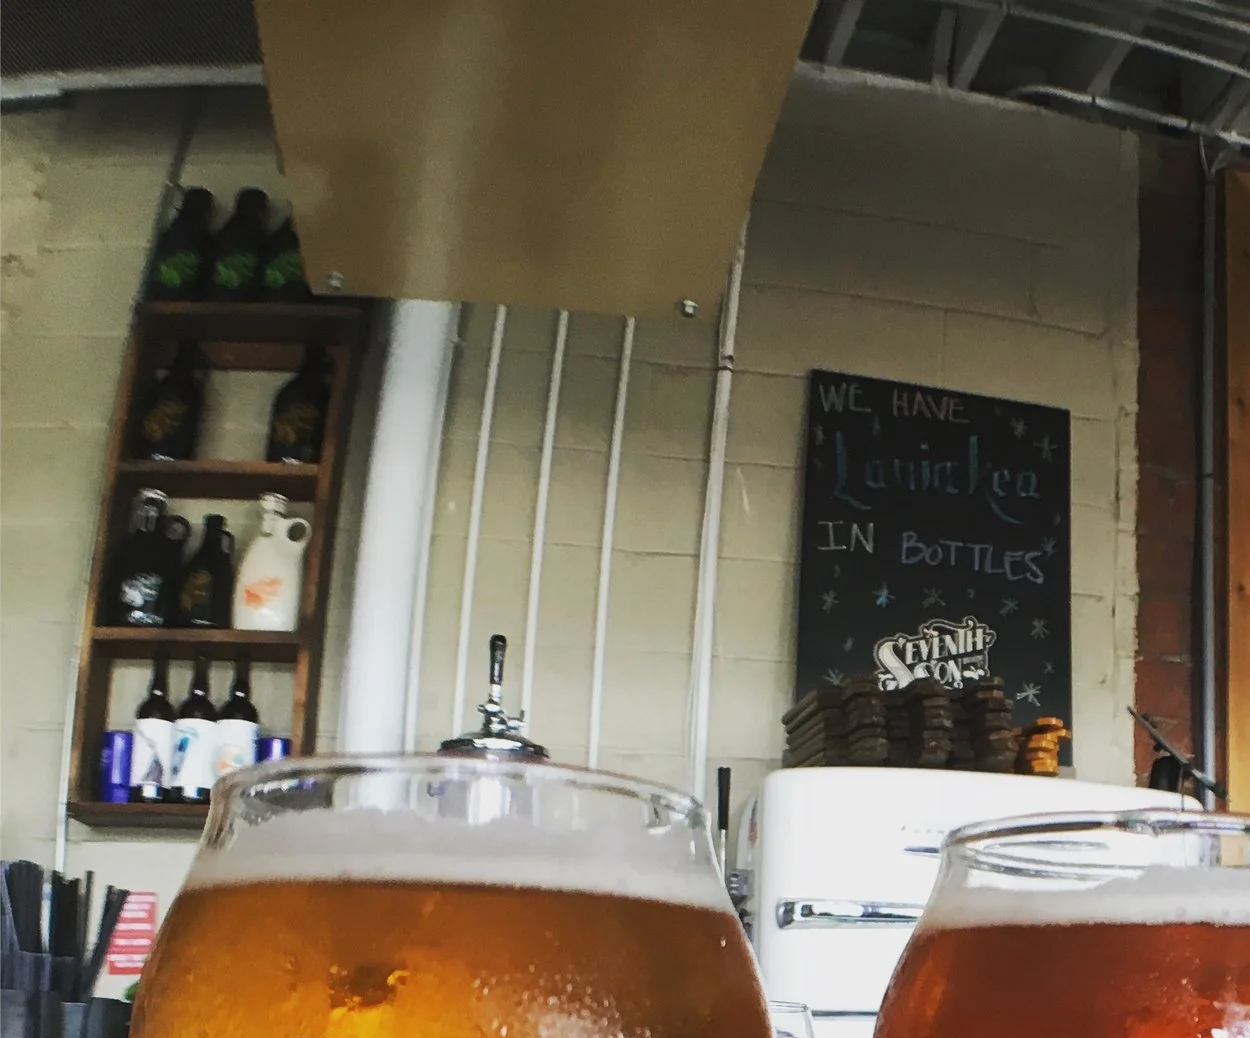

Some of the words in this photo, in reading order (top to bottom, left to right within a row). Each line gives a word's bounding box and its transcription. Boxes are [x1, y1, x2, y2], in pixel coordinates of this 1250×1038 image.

[819, 382, 872, 415] WE
[892, 387, 971, 424] HAVE
[817, 520, 876, 555] IN
[901, 531, 1045, 585] BOTTLES
[878, 627, 985, 691] SEVENTH
